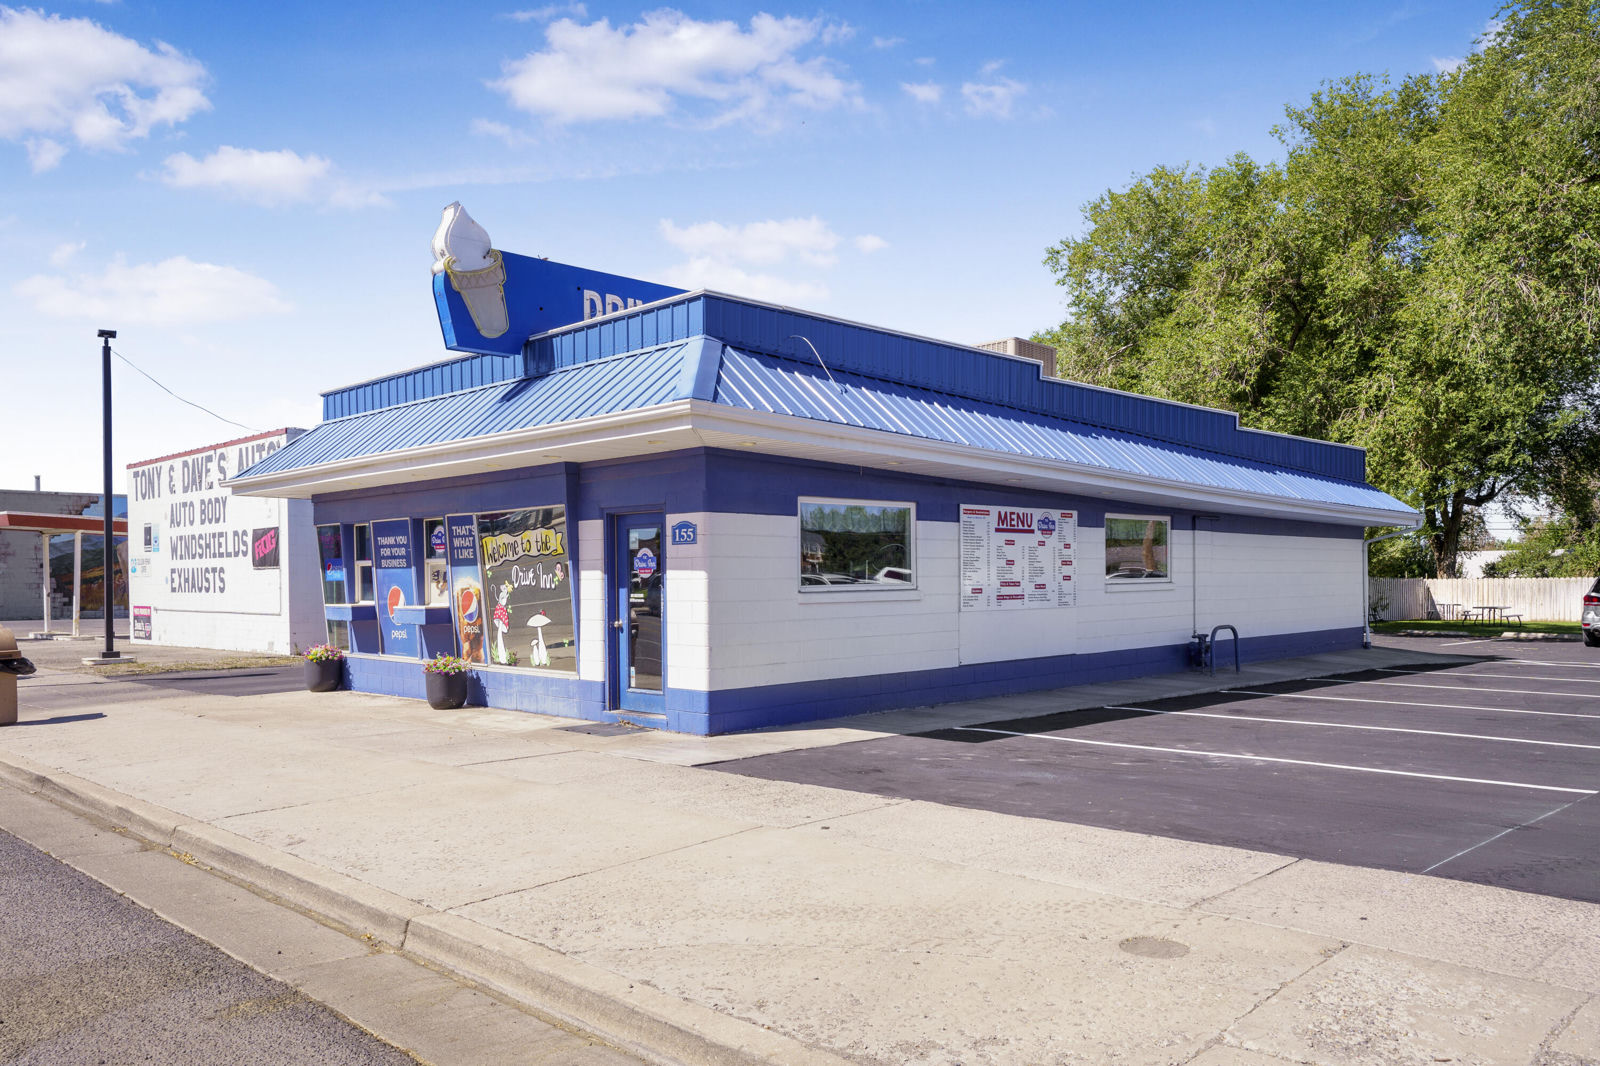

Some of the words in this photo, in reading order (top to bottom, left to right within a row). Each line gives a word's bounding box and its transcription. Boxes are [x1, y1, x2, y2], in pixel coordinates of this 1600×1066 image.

[133, 465, 162, 501] TONY
[168, 464, 176, 494] &
[182, 449, 226, 494] DAVE'S
[170, 500, 195, 529] AUTO
[200, 496, 227, 525] BODY
[997, 510, 1034, 529] MENU
[452, 525, 475, 537] THAT'S
[674, 528, 694, 542] 155
[170, 529, 249, 561] WINDSHIELDS
[377, 536, 396, 545] THANK
[396, 535, 408, 545] YOU
[453, 537, 474, 548] WHAT
[380, 548, 391, 556] FOR
[391, 547, 407, 556] YOUR
[454, 549, 458, 559] I
[459, 548, 474, 559] LIKE
[484, 540, 520, 565] Welcome
[520, 537, 532, 554] to
[535, 532, 551, 553] the
[381, 559, 407, 568] BUSINESS
[170, 566, 226, 594] EXHAUSTS
[511, 564, 536, 589] Drive
[537, 562, 556, 590] Inn
[391, 629, 408, 640] pepsi
[463, 624, 481, 635] pepsi
